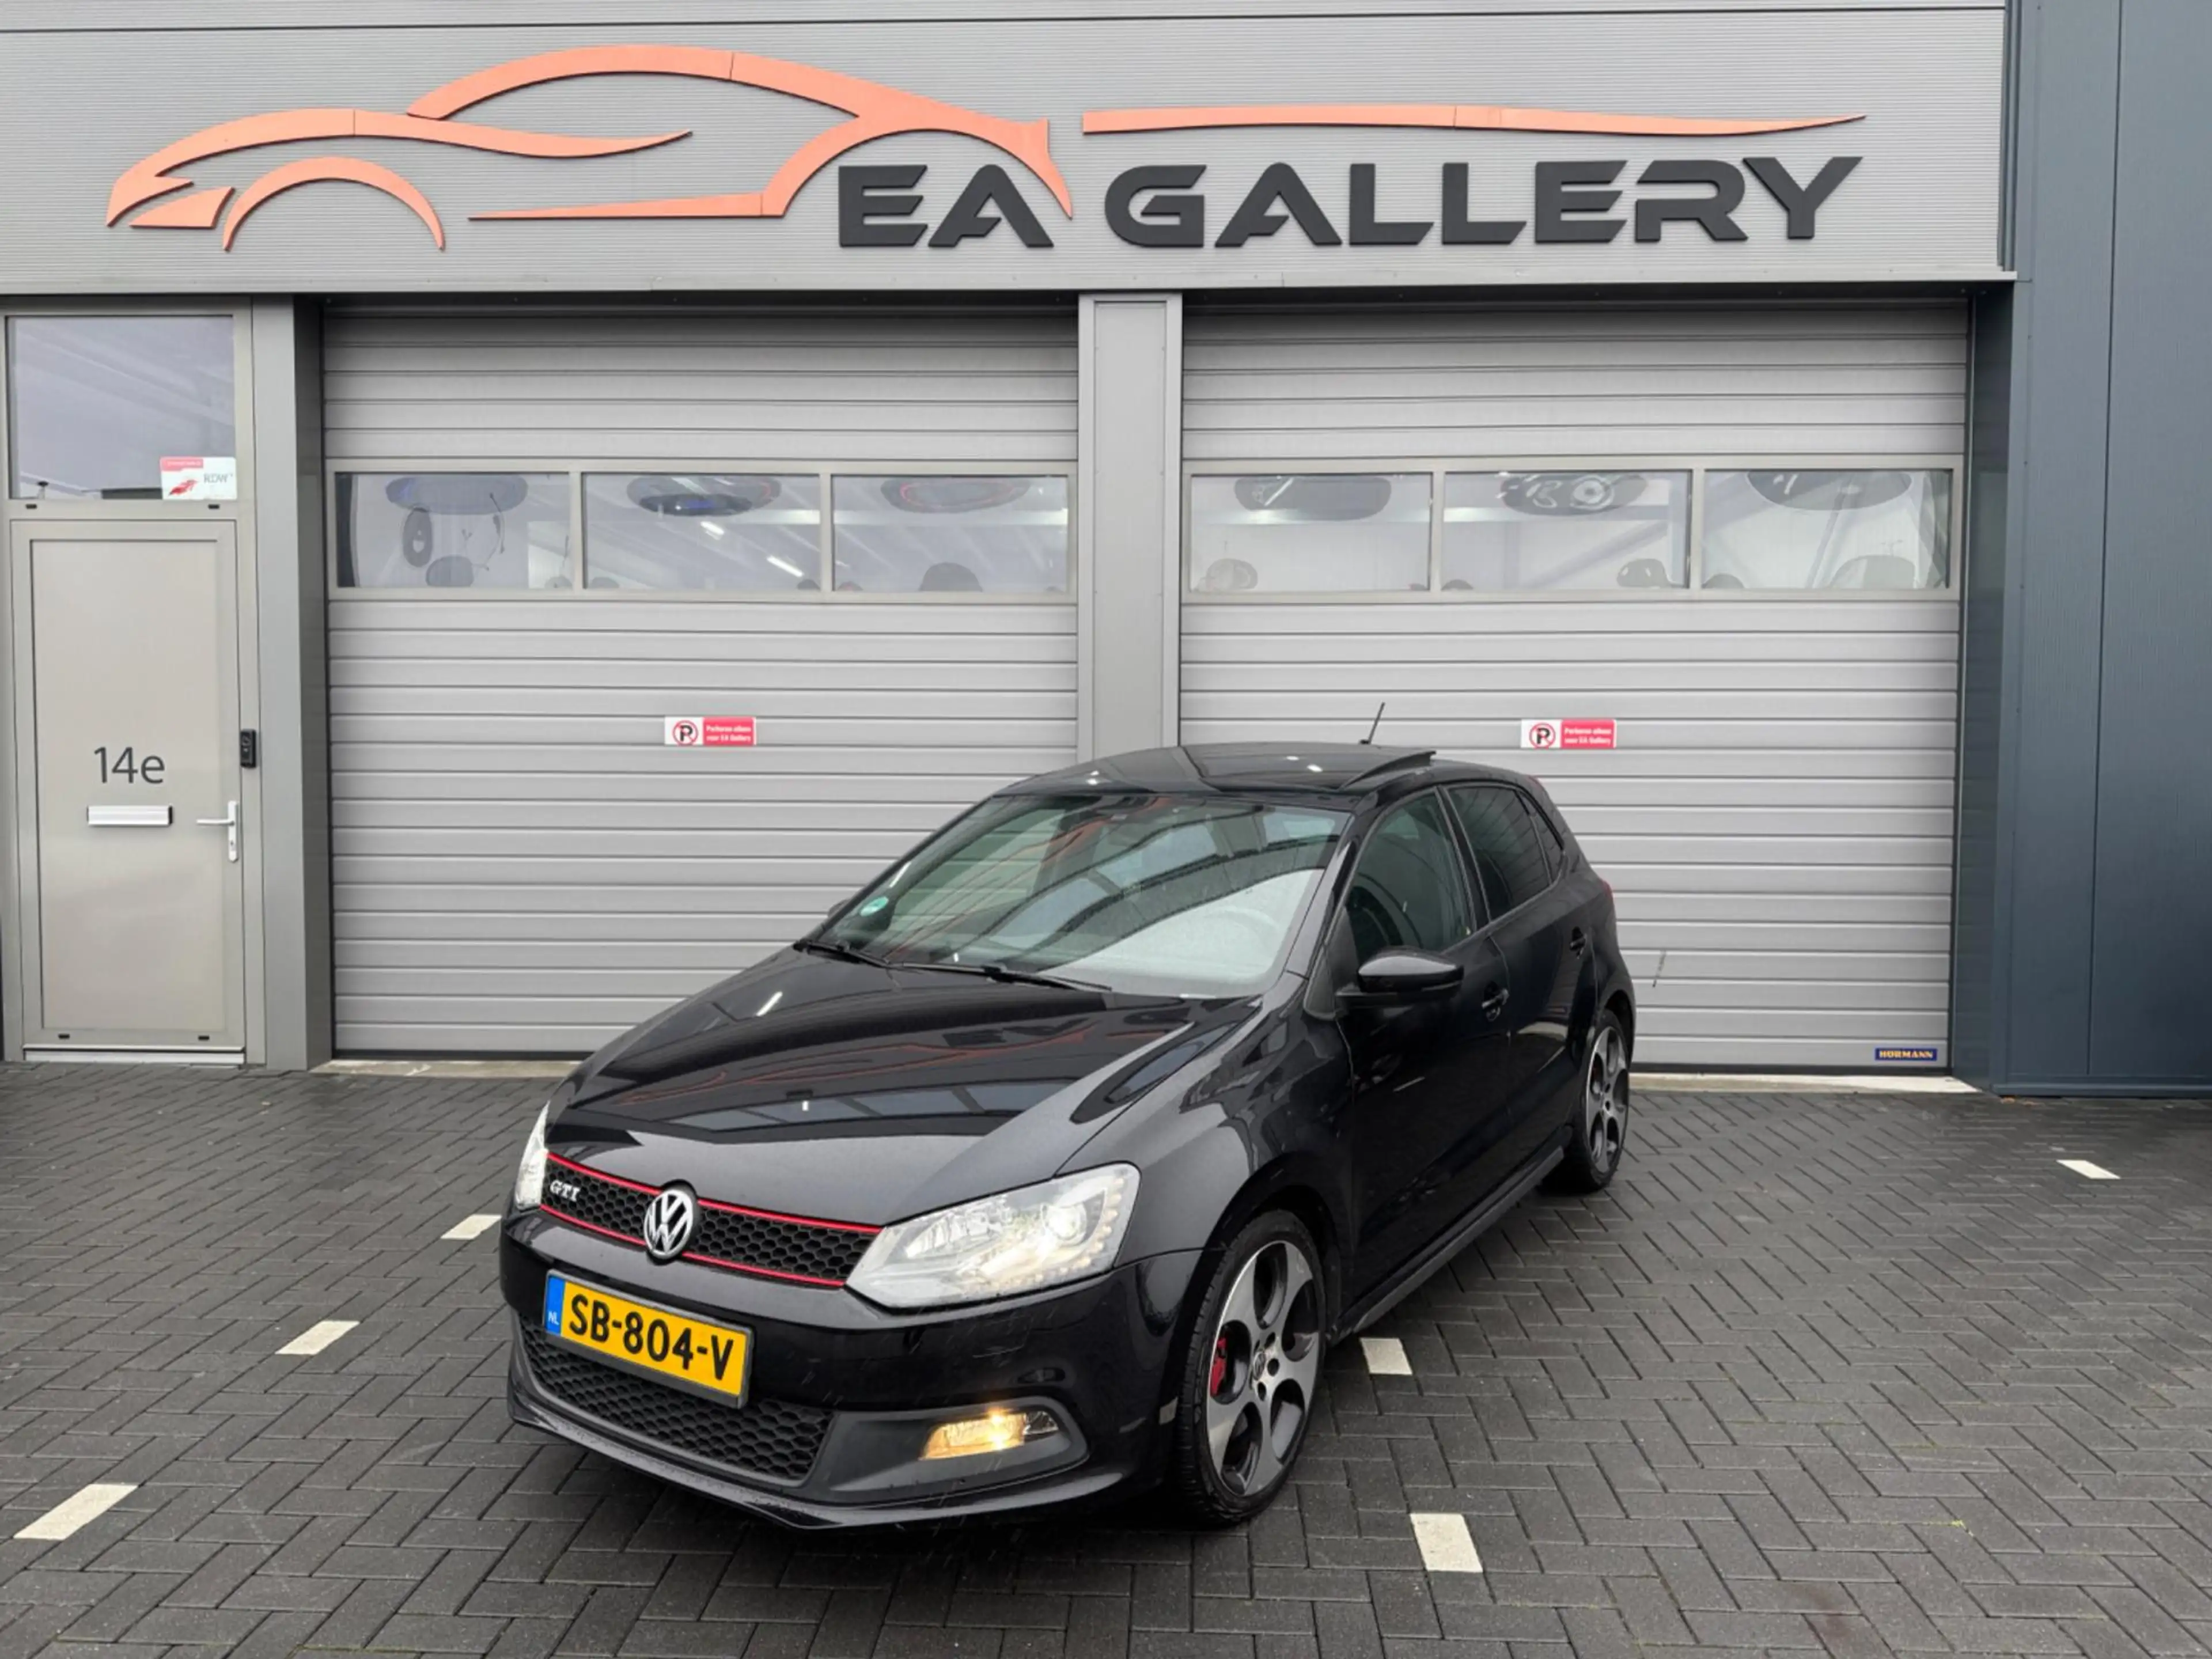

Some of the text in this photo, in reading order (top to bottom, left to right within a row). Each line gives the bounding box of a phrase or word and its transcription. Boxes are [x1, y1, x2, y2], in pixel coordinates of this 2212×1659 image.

[838, 156, 1864, 248] EA GALLERY
[94, 746, 166, 785] 14e
[549, 1179, 581, 1202] GTI
[547, 1311, 560, 1326] NL
[569, 1293, 734, 1381] SB-804-V
